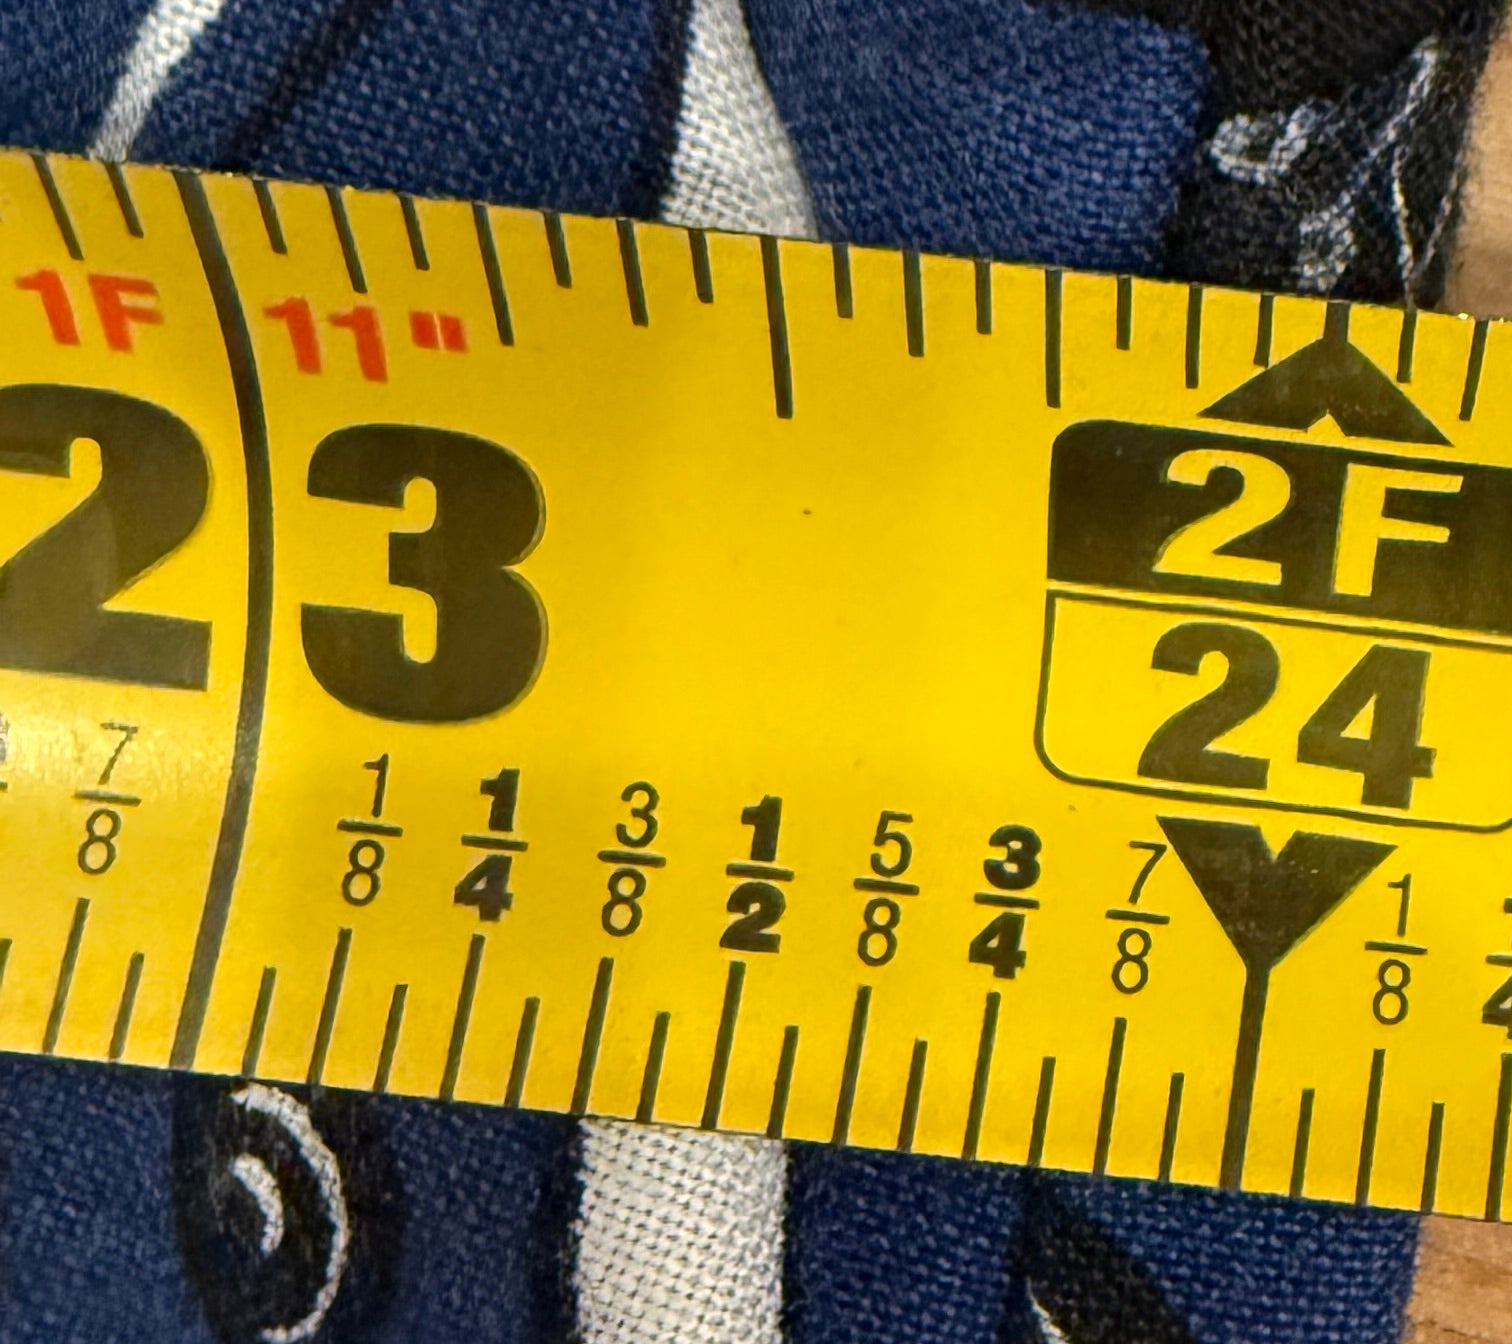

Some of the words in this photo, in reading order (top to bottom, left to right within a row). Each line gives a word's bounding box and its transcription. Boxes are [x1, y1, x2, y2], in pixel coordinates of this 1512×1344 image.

[15, 268, 164, 353] 1F
[1151, 449, 1464, 598] 2F
[1137, 621, 1437, 811] 24
